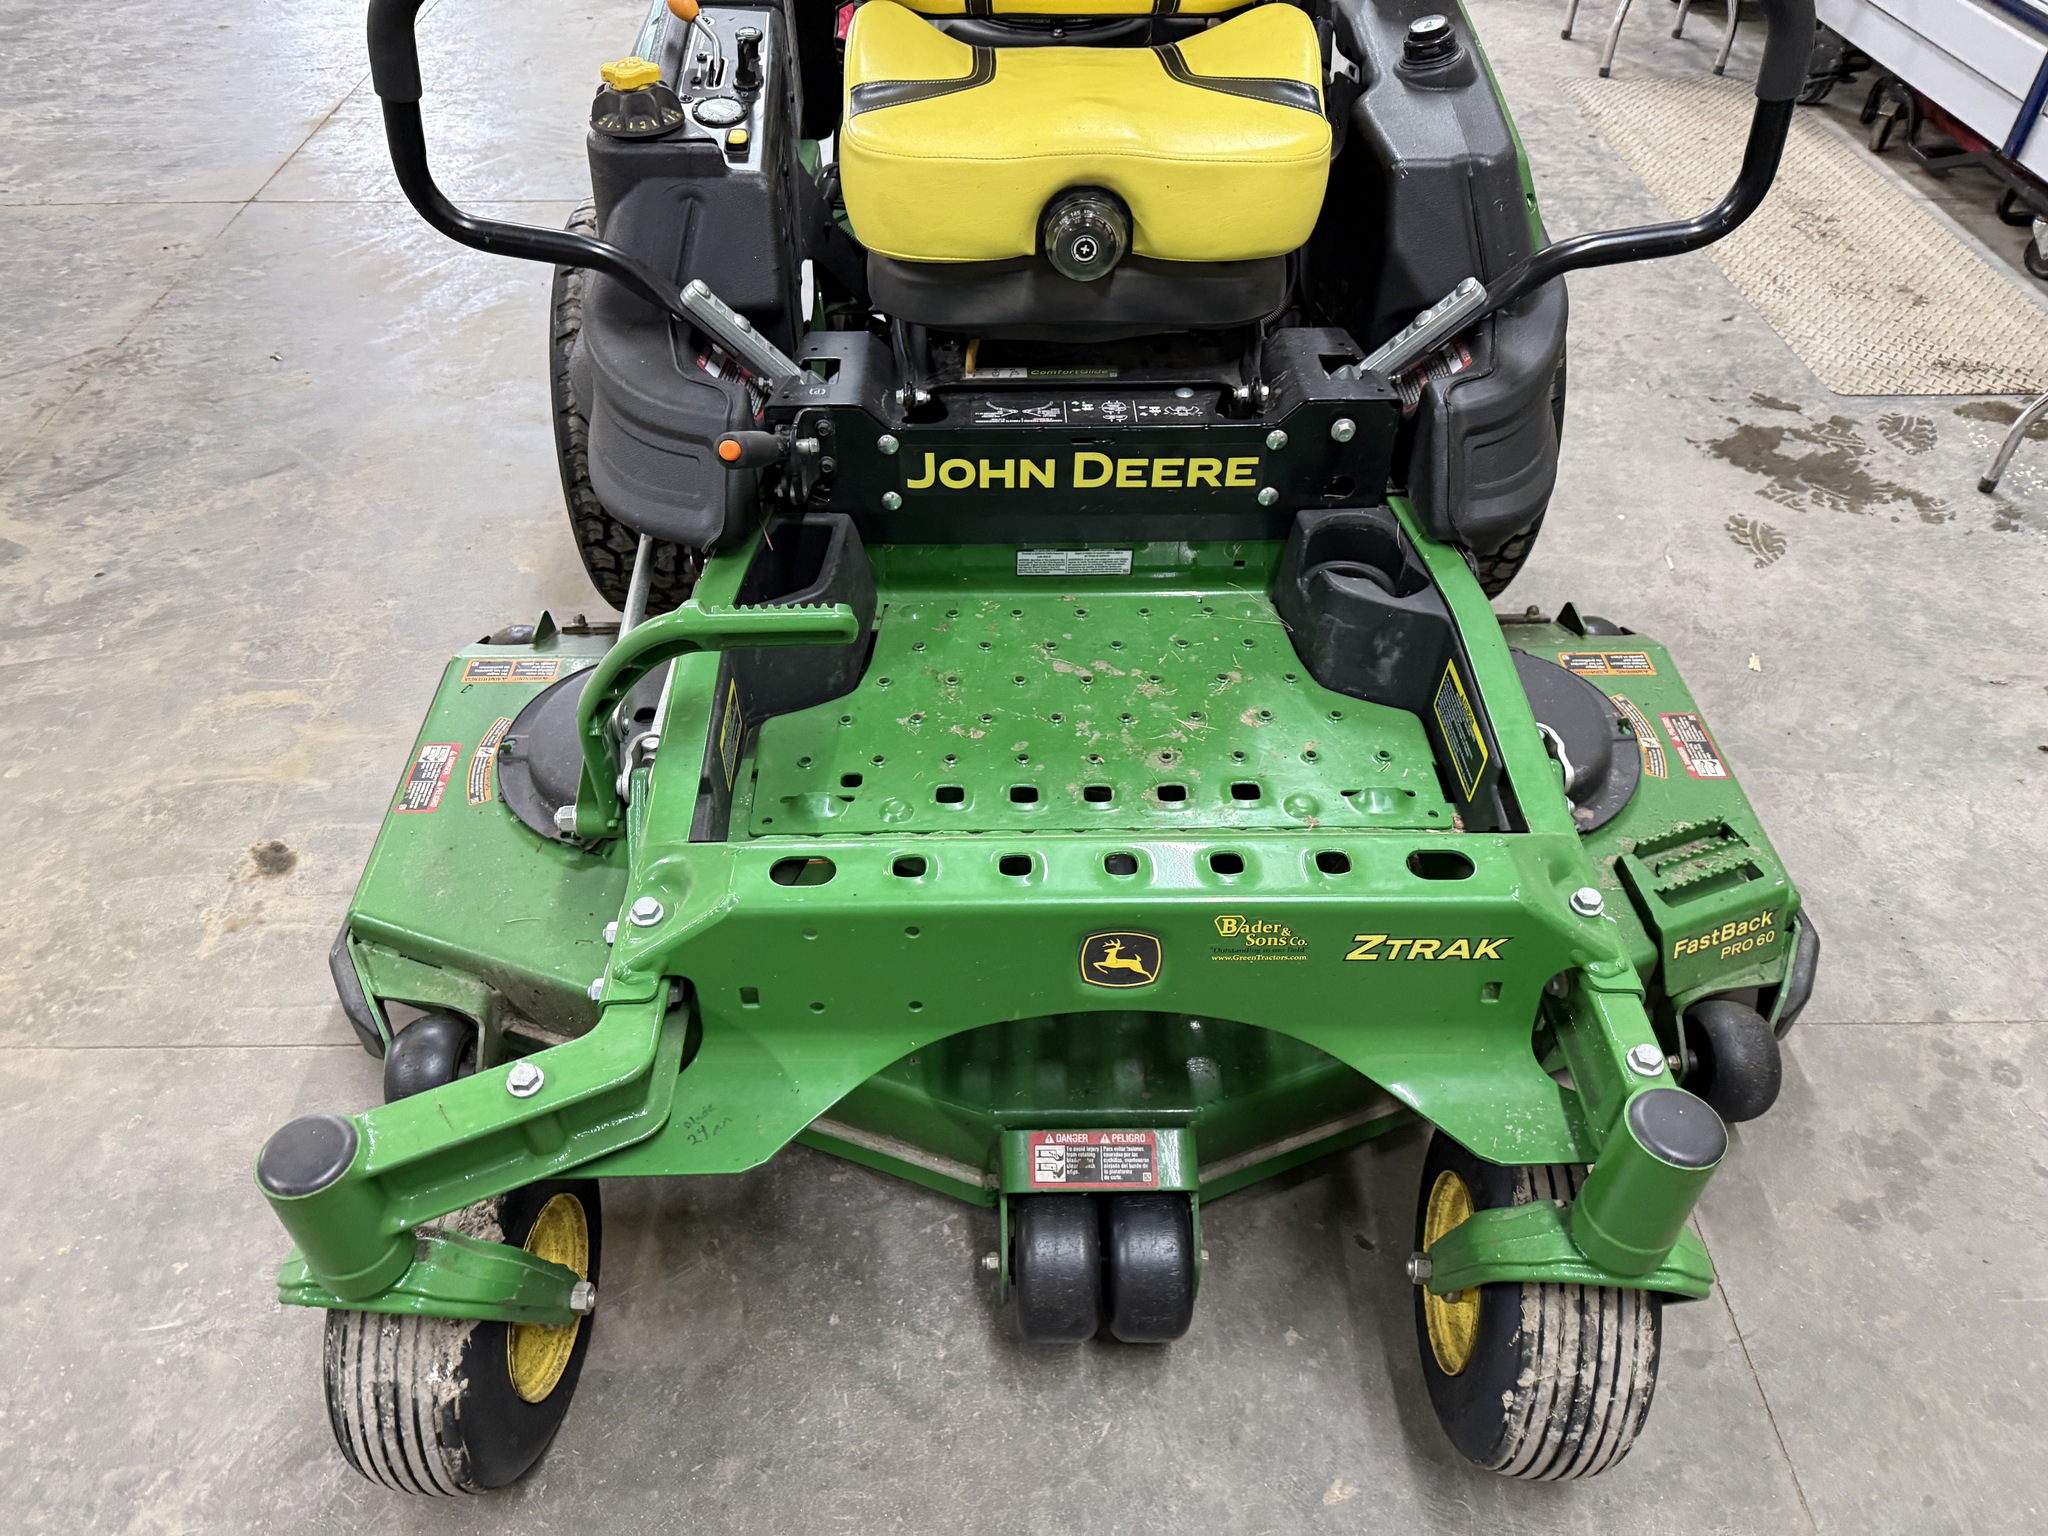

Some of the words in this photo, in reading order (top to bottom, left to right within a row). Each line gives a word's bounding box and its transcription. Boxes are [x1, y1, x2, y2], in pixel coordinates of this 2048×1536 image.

[906, 452, 1056, 489] JOHN
[1073, 452, 1260, 489] DEERE
[1220, 916, 1282, 934] Bader
[1281, 927, 1291, 937] &
[1673, 910, 1774, 960] FastBack
[1245, 933, 1287, 946] Sons
[1289, 936, 1308, 946] Co.
[1343, 934, 1510, 961] ZTRAK
[1720, 938, 1754, 959] PRO
[1756, 930, 1775, 947] 60
[1055, 1133, 1089, 1143] DANGER
[1111, 1133, 1146, 1143] PELIGRO
